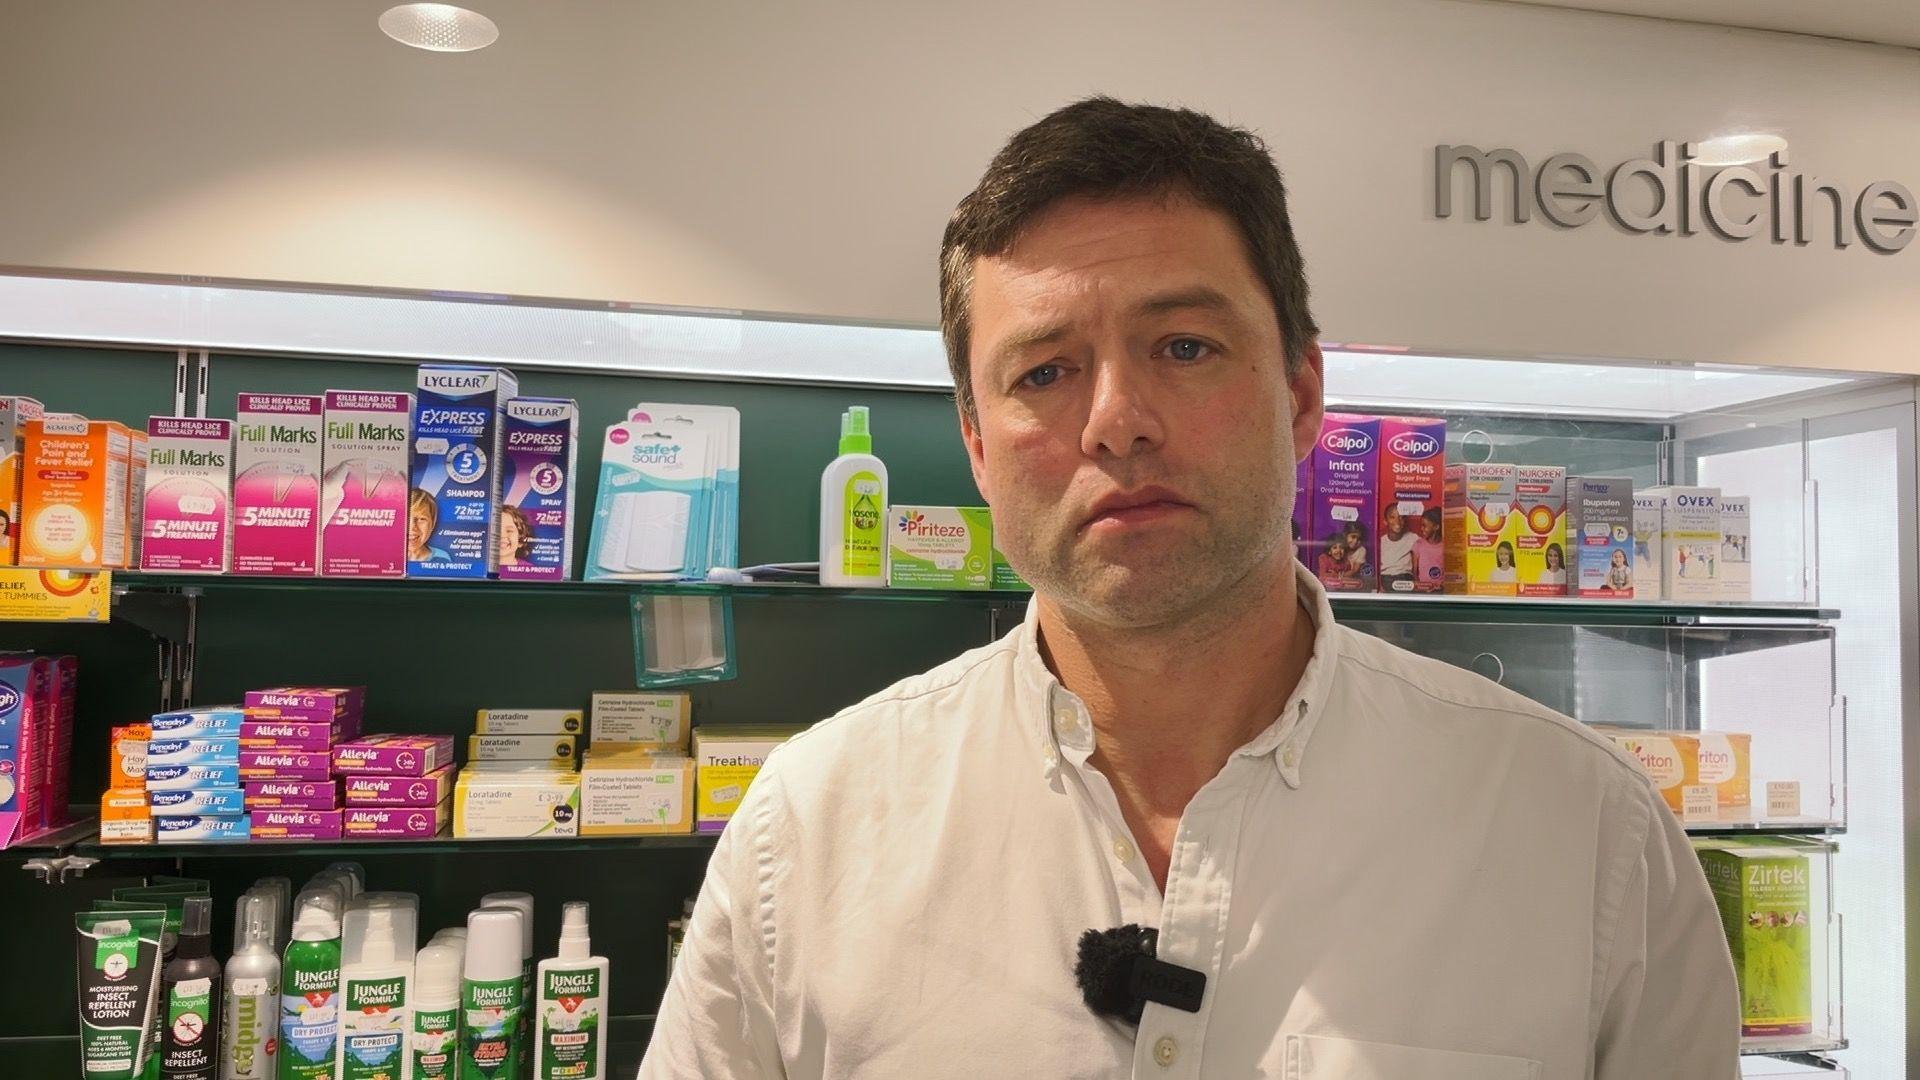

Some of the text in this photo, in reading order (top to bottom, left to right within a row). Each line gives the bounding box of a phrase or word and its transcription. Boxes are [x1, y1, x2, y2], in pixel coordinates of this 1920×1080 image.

[1434, 140, 1920, 255] medicine
[425, 375, 481, 388] LYCLEAR
[337, 394, 356, 402] KILLS
[514, 406, 559, 417] LYCLEAR
[420, 409, 485, 425] EXPRESS
[158, 421, 221, 430] KILLS HEAD LICE
[240, 425, 317, 443] Full Marks
[328, 422, 405, 441] Full Marks
[510, 431, 563, 445] EXPRESS
[1327, 435, 1368, 451] Calpol
[40, 440, 90, 450] Children's
[1393, 439, 1433, 454] Calpol
[41, 450, 87, 458] Pain and
[150, 449, 224, 467] Full Marks
[632, 454, 677, 464] sound
[35, 457, 93, 467] Fever Relief
[461, 453, 472, 468] 5
[1329, 460, 1364, 471] Infant
[1392, 463, 1434, 475] SixPlus
[1470, 467, 1512, 476] NUROFEN
[1519, 470, 1561, 478] NUROFEN
[543, 471, 552, 482] 5
[446, 490, 485, 498] SHAMPOO
[1583, 499, 1620, 508] Ibuprofen
[1677, 495, 1714, 507] OVEX
[242, 507, 311, 526] 5 MINUTE
[335, 508, 396, 525] 5 MINUTE
[258, 519, 309, 528] TREATMENT
[350, 519, 394, 527] TREATMENT
[152, 520, 219, 538] 5 MINUTE
[907, 520, 965, 537] Piriteze
[166, 531, 216, 540] TREATMENT
[0, 582, 26, 591] ELIEF,
[4, 592, 48, 601] TUMMIES
[261, 694, 299, 706] Allevia
[154, 719, 228, 728] Benadryl RELIEF
[128, 728, 145, 736] Hay
[255, 725, 294, 736] Allevia
[193, 745, 224, 753] RELIEF
[340, 749, 377, 759] Allevia
[254, 755, 293, 766] Allevia
[1639, 755, 1672, 768] riton
[1699, 751, 1729, 764] riton
[149, 769, 223, 779] Benadryl RELIEF
[261, 784, 299, 795] Allevia
[352, 780, 390, 791] Allevia
[153, 794, 186, 802] Benadryl
[266, 813, 305, 824] Allevia
[351, 812, 388, 823] Allevia
[203, 822, 235, 830] RELIEF
[1749, 865, 1805, 885] Zirtek
[99, 940, 137, 950] incognito
[295, 969, 338, 987] JUNGLE
[550, 973, 594, 990] JUNGLE
[89, 985, 138, 993] MOISTURISING
[299, 981, 337, 990] FORMULA
[554, 986, 591, 994] FORMULA
[97, 993, 129, 1001] INSECT
[354, 983, 400, 1001] JUNGLE
[473, 986, 514, 1001] JUNGLE
[88, 1001, 136, 1010] REPELLENT
[170, 998, 208, 1009] incognito
[358, 996, 398, 1005] FORMULA
[476, 997, 511, 1006] FORMULA
[93, 1010, 130, 1019] LOTION
[421, 1015, 450, 1026] JUNGLE
[368, 1037, 395, 1045] PROTECT
[554, 1034, 586, 1043] MAXIMUM
[171, 1050, 202, 1059] INSECT
[165, 1058, 208, 1067] REPELLENT
